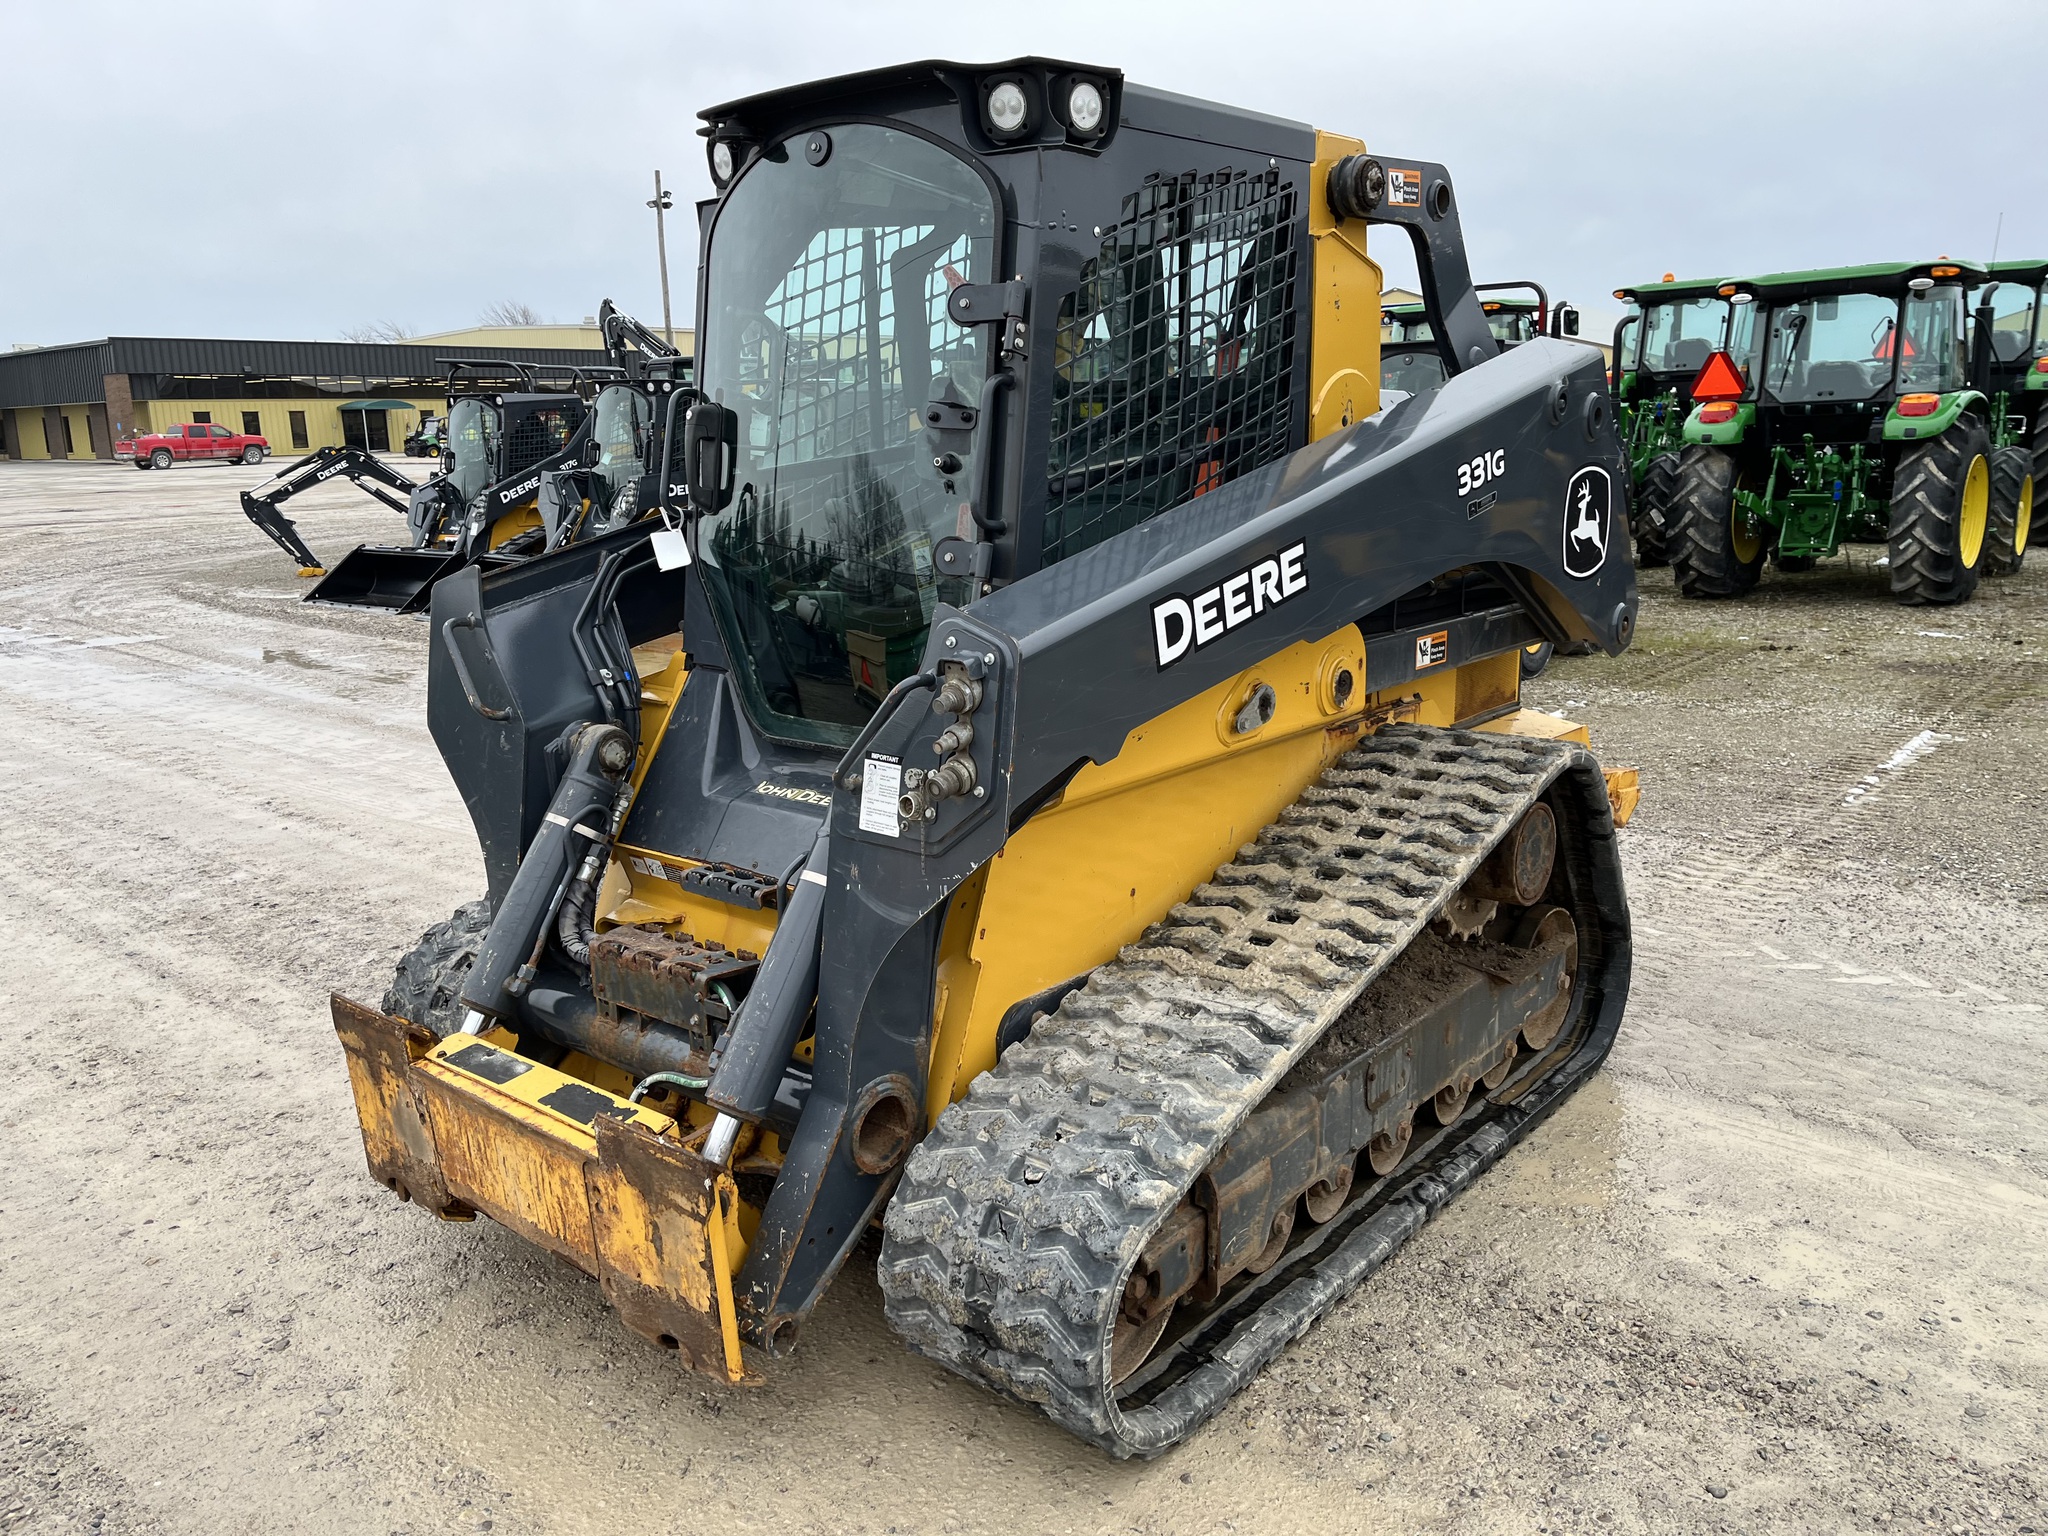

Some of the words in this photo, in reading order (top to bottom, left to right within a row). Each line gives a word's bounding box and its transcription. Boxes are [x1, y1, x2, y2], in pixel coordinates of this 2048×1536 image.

[316, 460, 350, 481] DEERE
[1457, 448, 1505, 496] 331G
[499, 476, 540, 504] DEERE
[1154, 542, 1307, 667] DEERE
[871, 752, 900, 764] IMPORTANT
